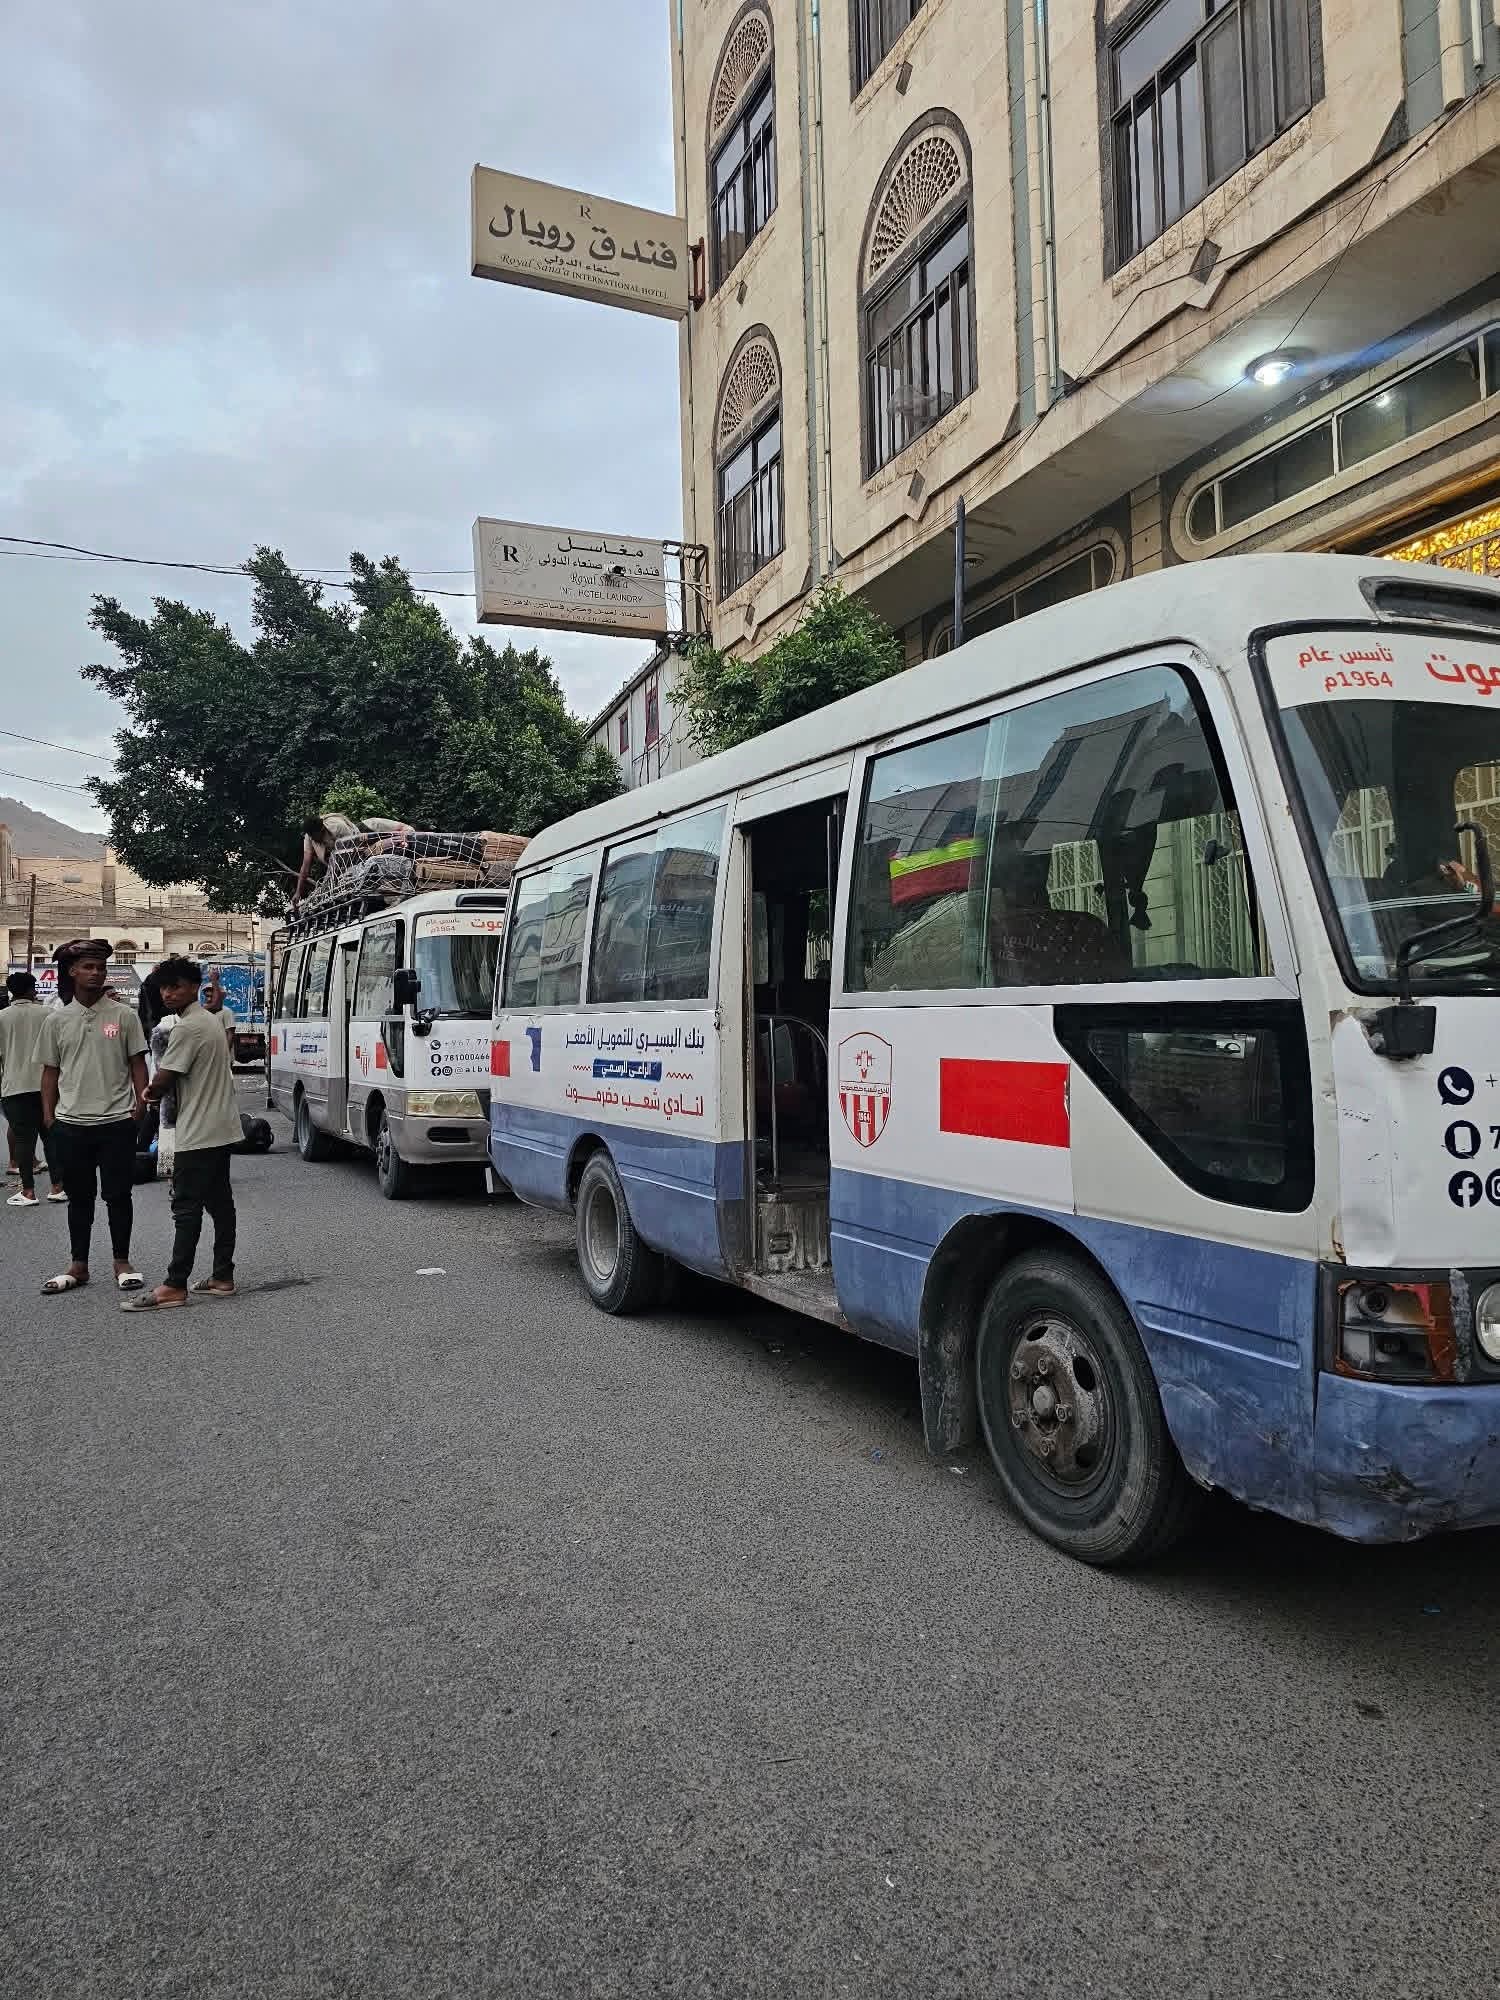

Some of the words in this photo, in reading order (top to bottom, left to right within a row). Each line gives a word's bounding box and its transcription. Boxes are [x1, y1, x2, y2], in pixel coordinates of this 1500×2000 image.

[579, 204, 592, 219] R
[488, 204, 576, 253] رويال
[589, 226, 677, 271] فندق
[543, 255, 582, 268] الدولي
[585, 263, 621, 277] صنعاء
[501, 255, 533, 269] Royal
[571, 272, 640, 293] INTERNATIONAL
[641, 287, 668, 300] HOTEL
[503, 545, 519, 563] R
[557, 536, 644, 559] مغاسل
[538, 553, 570, 567] الدولي
[572, 558, 602, 570] صنعاء
[634, 565, 660, 577] فندق
[570, 572, 597, 588] Royal
[578, 589, 603, 599] HOTEL
[606, 591, 643, 603] LAUNDRY
[1298, 645, 1334, 668] عام
[1339, 642, 1394, 665] تأسس
[1324, 671, 1393, 692] 1964م
[1425, 653, 1500, 696] موت
[471, 918, 504, 931] موت
[565, 1024, 596, 1049] الأصغر
[597, 1026, 634, 1051] للتمويل
[636, 1027, 682, 1054] البسيري
[684, 1026, 705, 1055] بنك
[455, 1065, 490, 1075] @albu
[601, 1060, 628, 1076] الرسمي
[565, 1082, 619, 1108] حضرموت
[621, 1088, 660, 1112] شعب
[663, 1093, 704, 1121] لنادي
